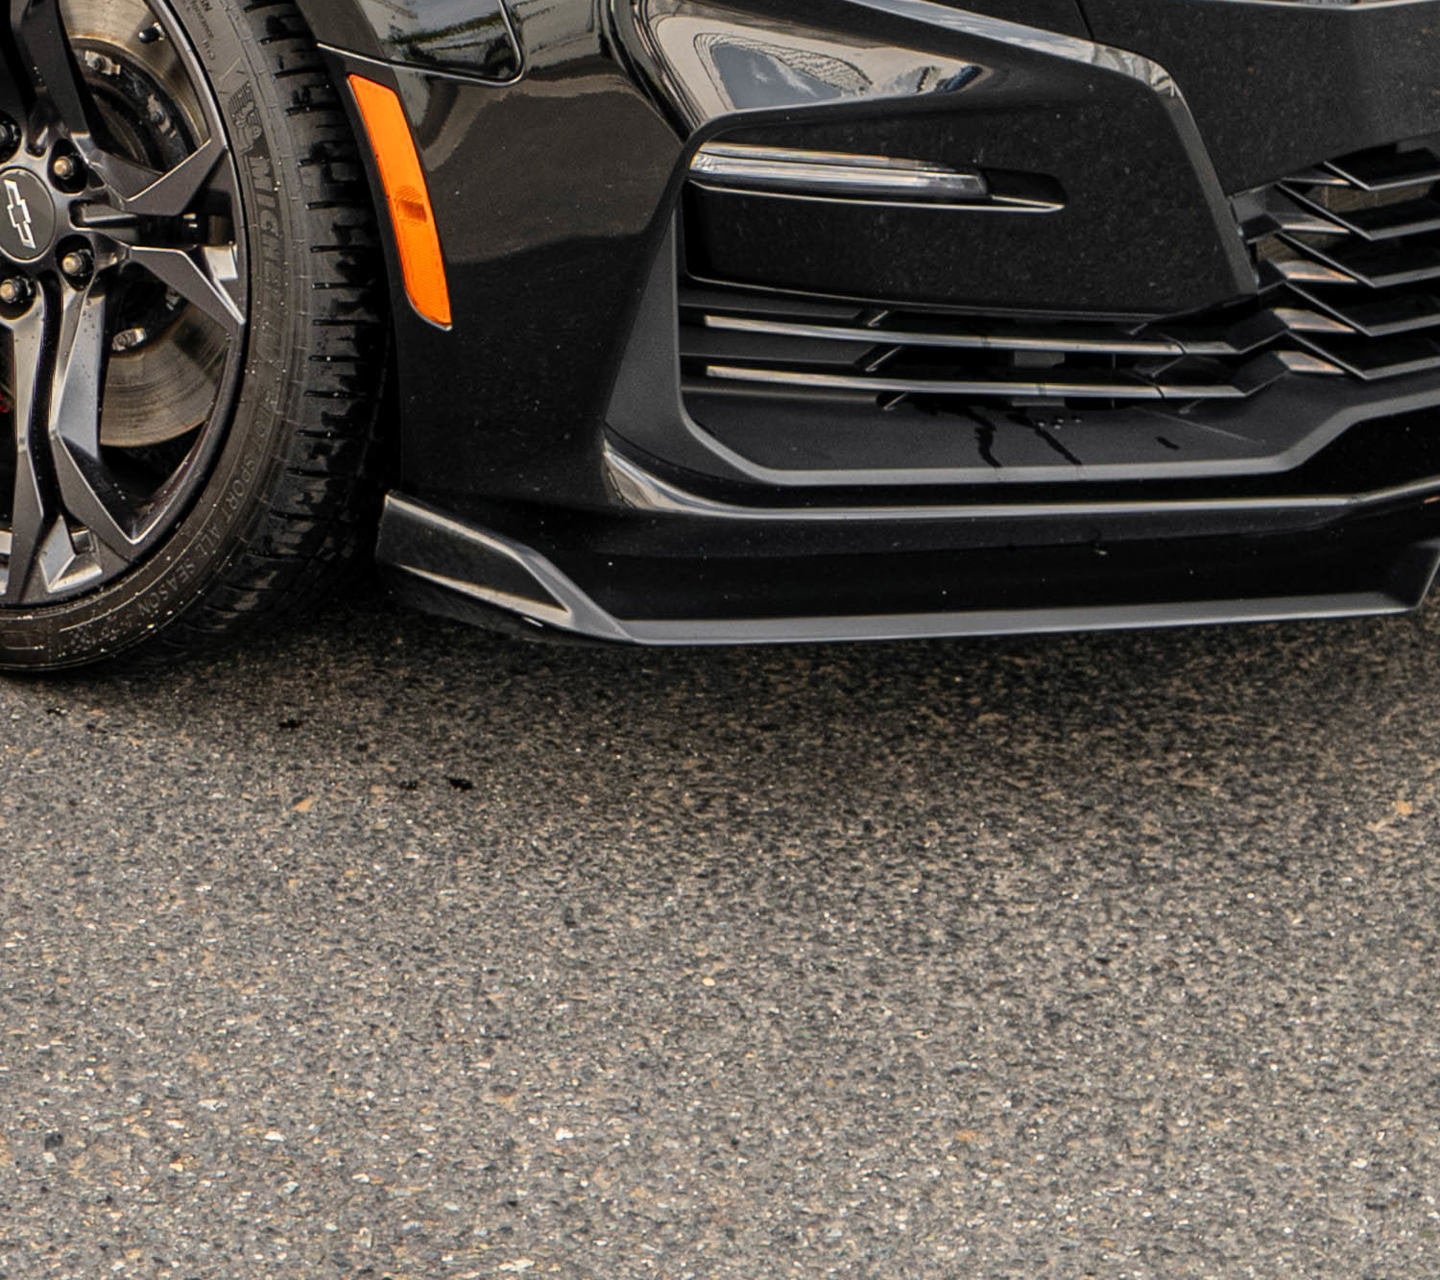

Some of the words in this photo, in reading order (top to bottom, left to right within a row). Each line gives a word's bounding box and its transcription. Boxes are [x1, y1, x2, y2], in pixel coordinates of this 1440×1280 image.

[220, 456, 257, 525] SPORT
[194, 523, 223, 559] ALL
[137, 559, 196, 615] SEASON
